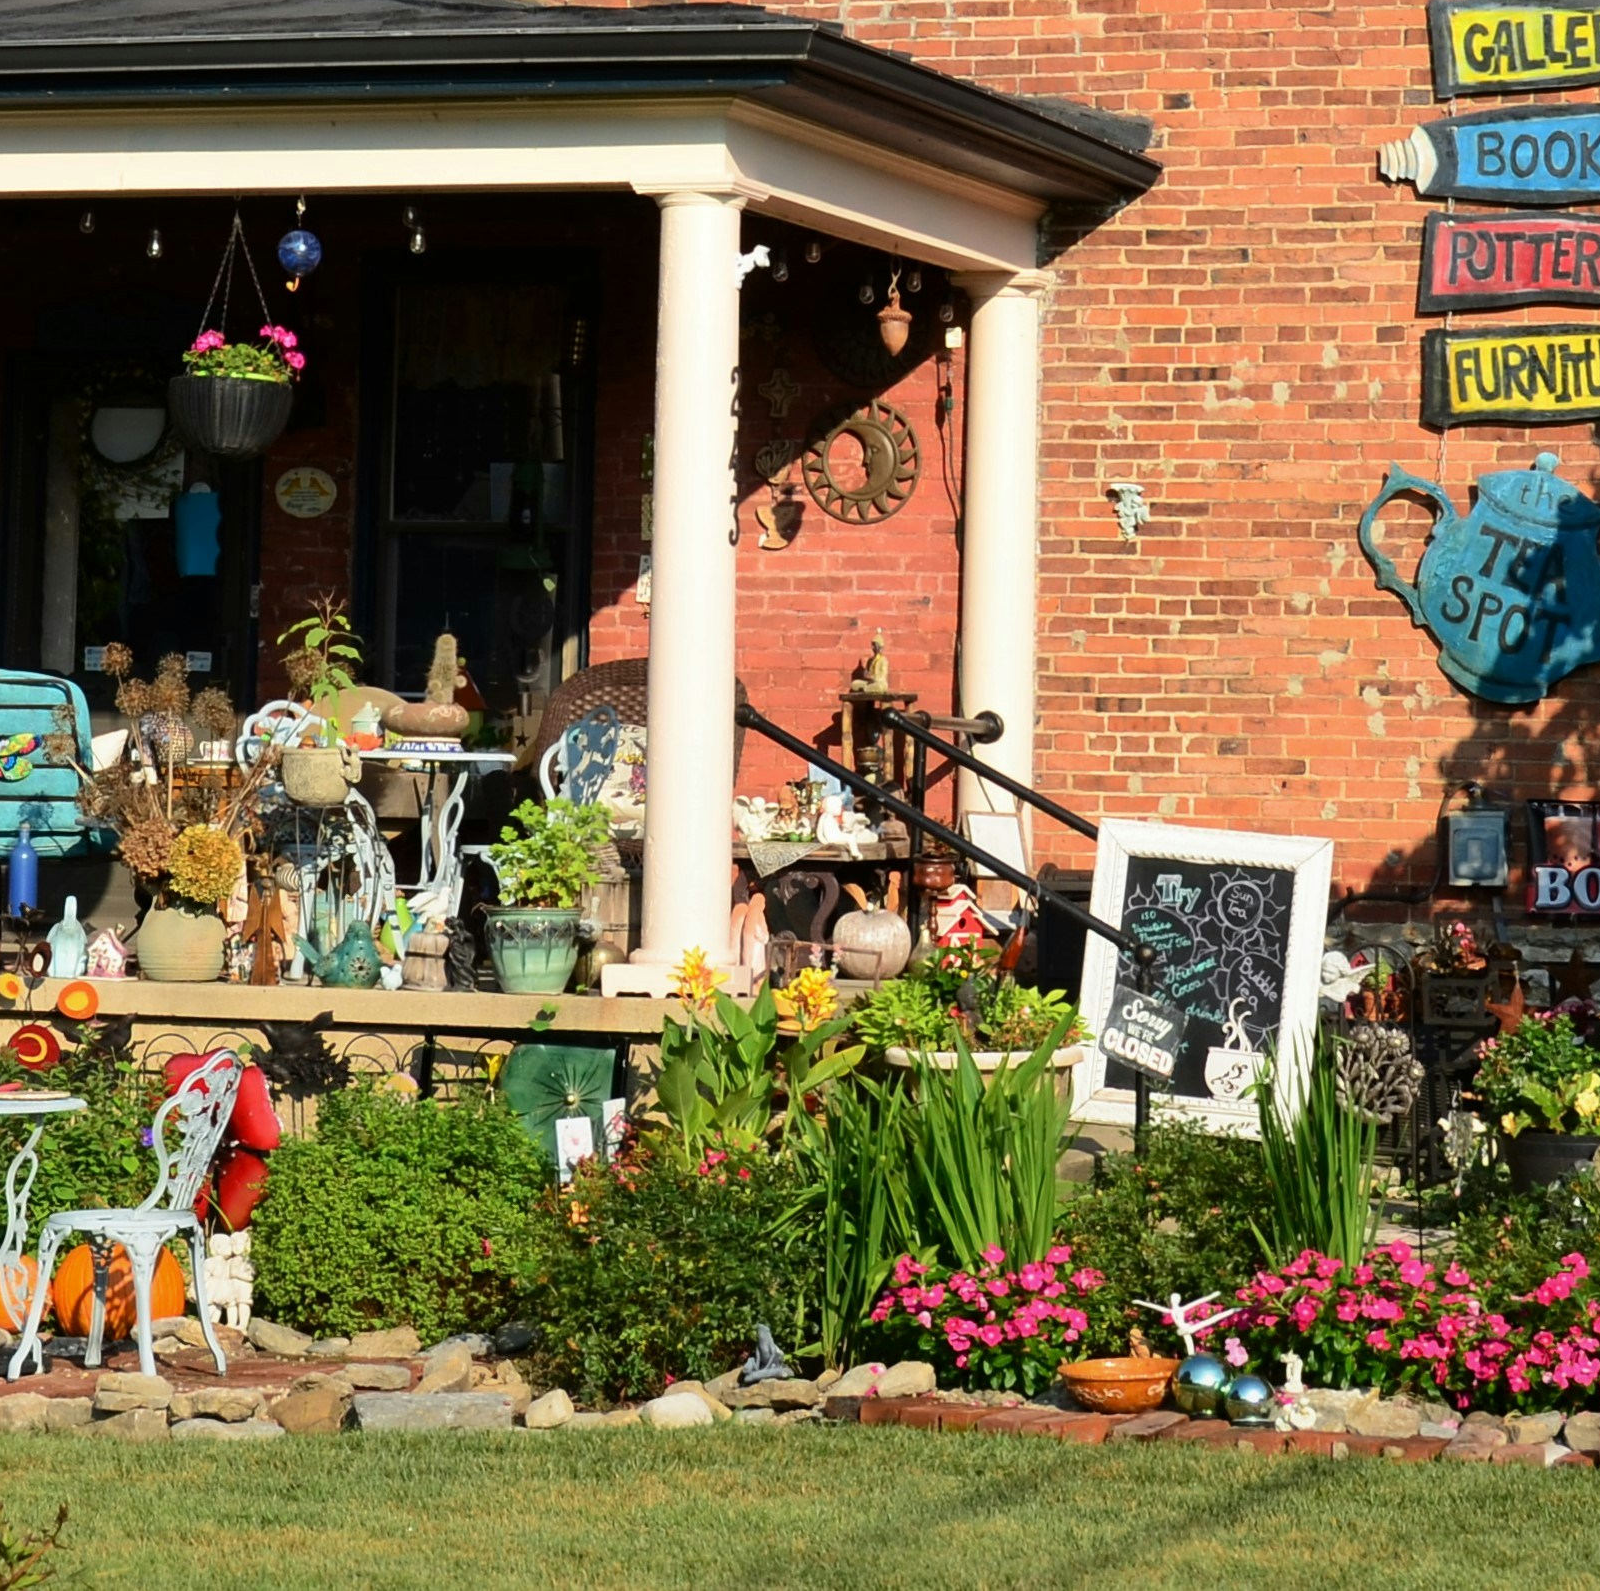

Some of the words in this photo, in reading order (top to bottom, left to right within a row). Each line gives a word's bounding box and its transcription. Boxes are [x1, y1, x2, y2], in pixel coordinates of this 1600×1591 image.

[1519, 476, 1576, 508] the
[1479, 523, 1568, 607] TEA
[1440, 575, 1571, 665] SPOT
[1156, 874, 1202, 913] Try
[1227, 898, 1247, 920] Tea
[1230, 885, 1255, 906] Sun
[1171, 979, 1206, 998] Cocoa
[1235, 974, 1259, 1012] Tea
[1239, 956, 1279, 1003] Bubble
[1122, 999, 1173, 1041] Sorry
[1185, 1002, 1227, 1025] drinks
[1103, 1027, 1174, 1077] CLOSED
